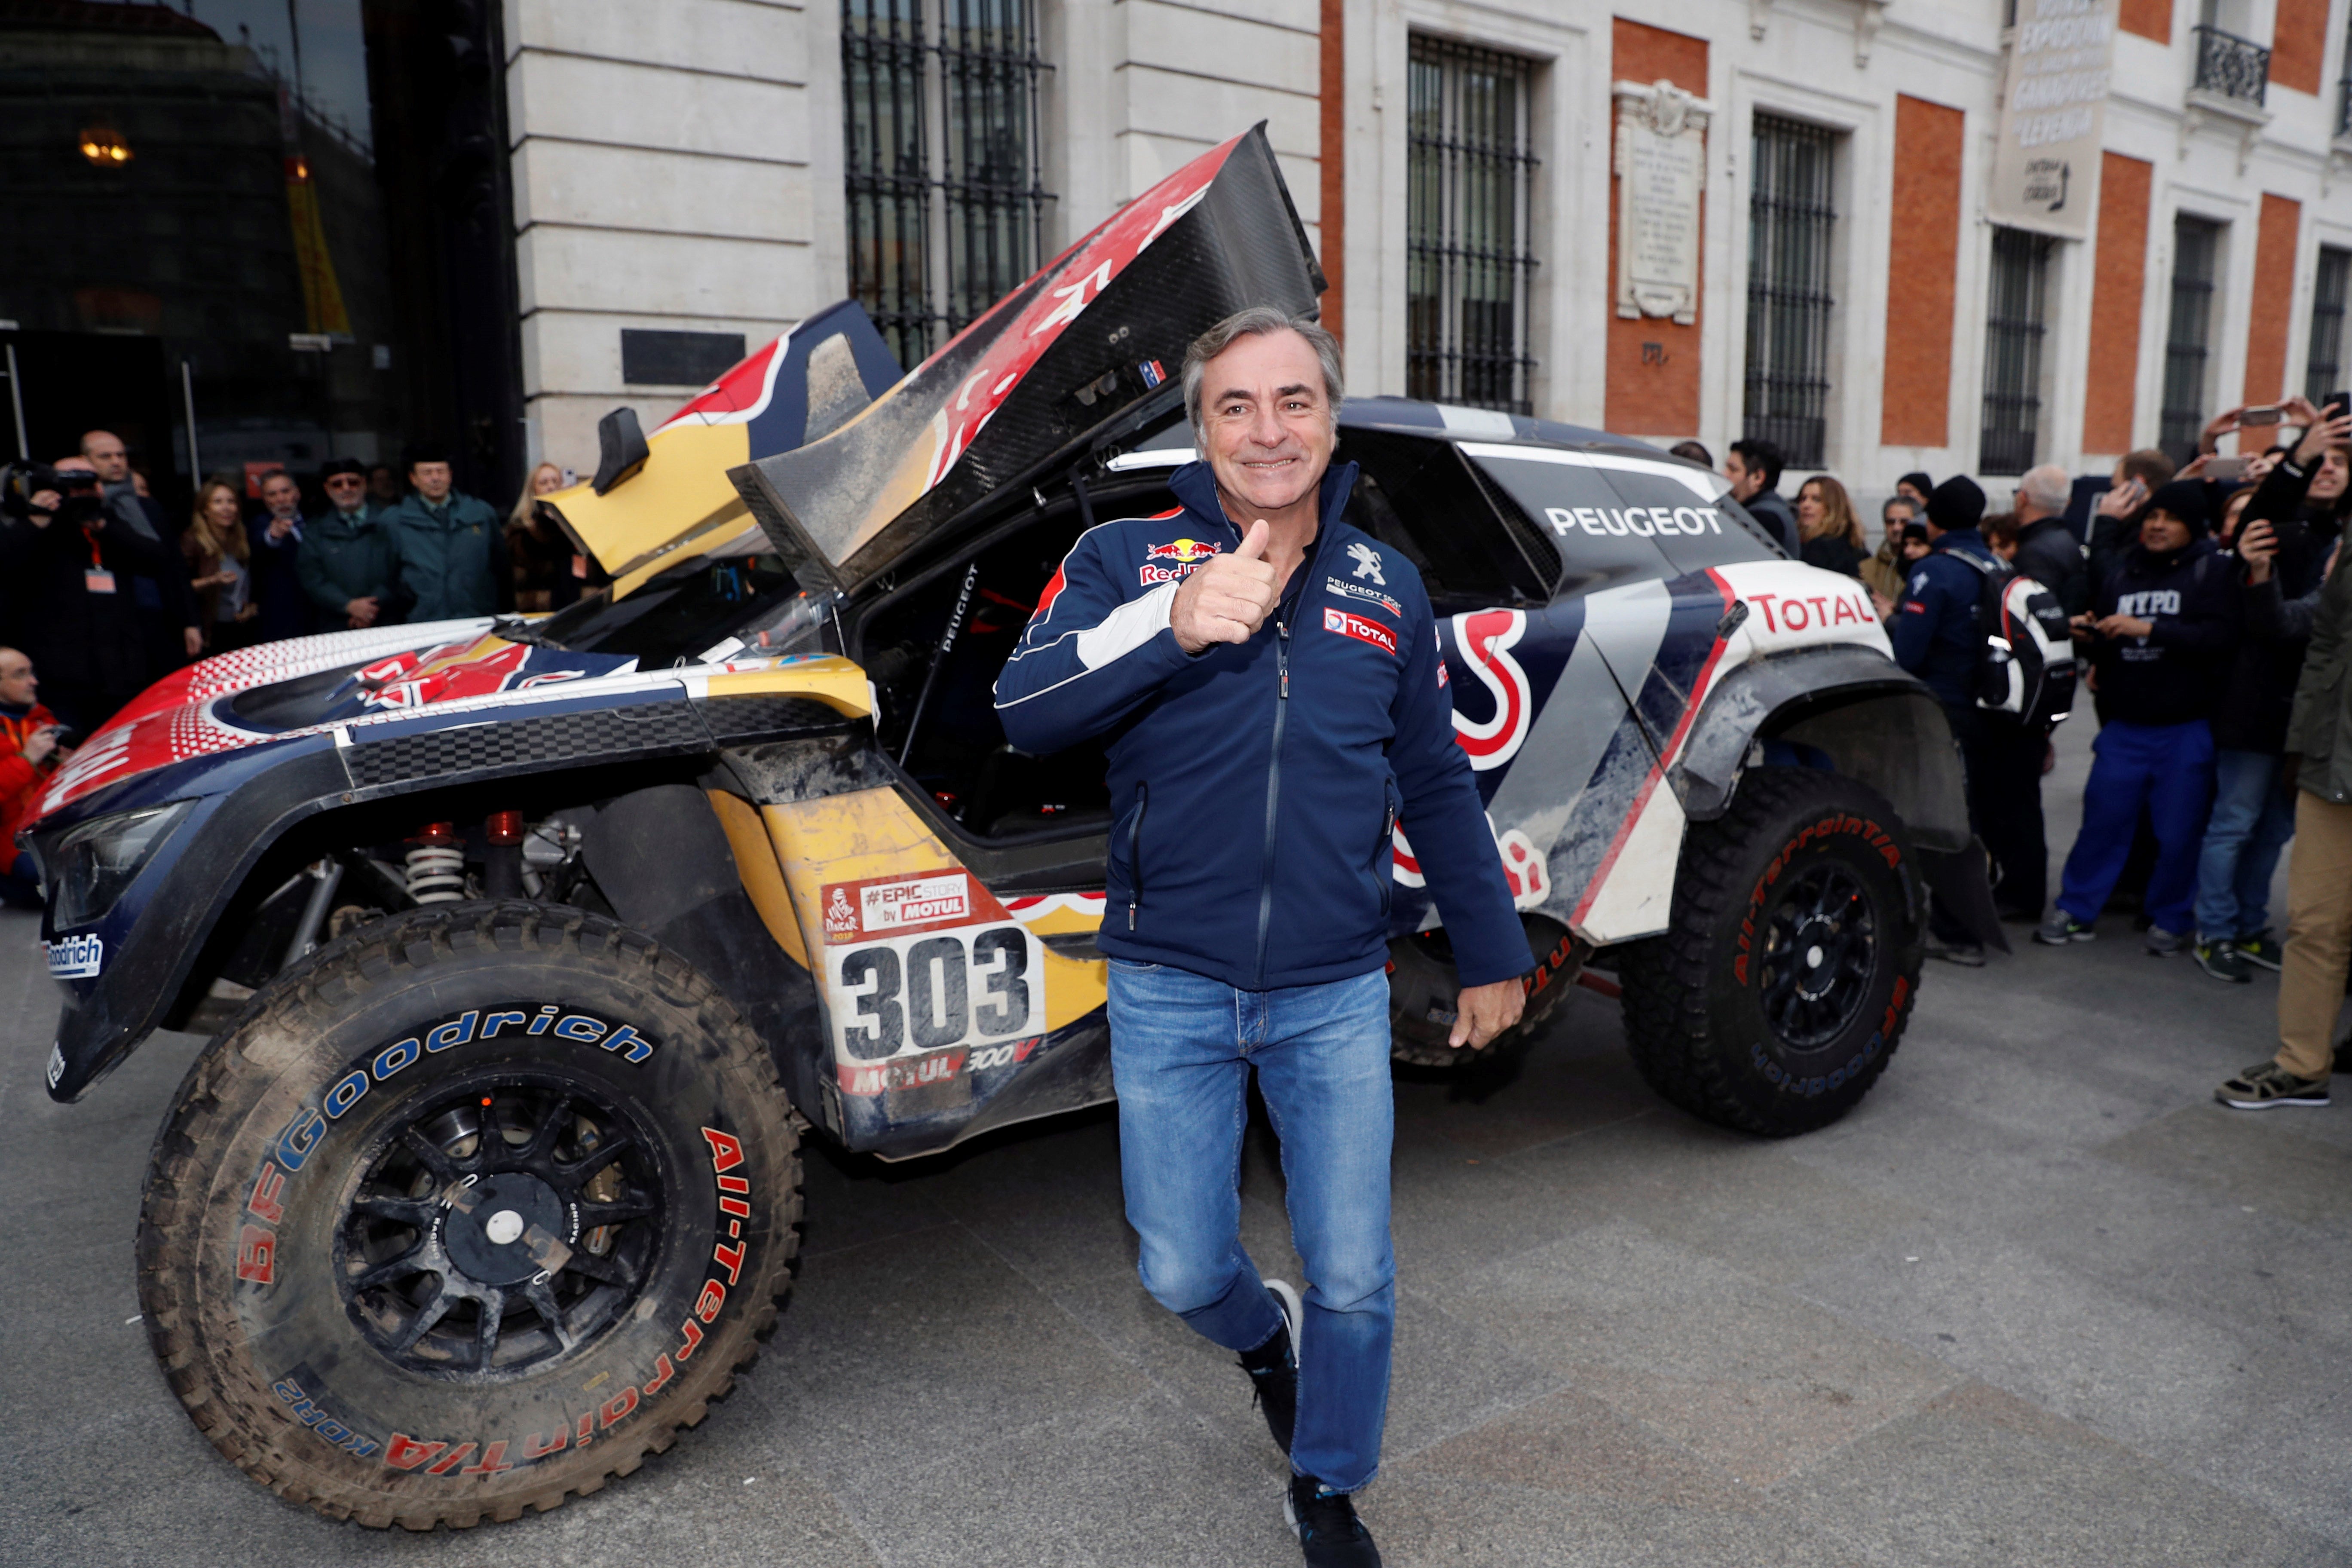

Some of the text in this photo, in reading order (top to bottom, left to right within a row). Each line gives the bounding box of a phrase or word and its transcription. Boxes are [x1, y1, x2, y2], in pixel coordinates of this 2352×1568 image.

[1544, 506, 1723, 538] PEUGEOT
[1140, 563, 1186, 586] Red
[1327, 576, 1382, 598] PEUGEOT
[942, 563, 978, 653] PEUGEOT
[1747, 594, 1874, 634] TOTAL
[1348, 619, 1395, 651] TOTAL
[825, 915, 859, 932] DAKAR
[883, 897, 963, 922] by MOTUL
[840, 927, 1029, 1061] 303
[966, 1037, 1041, 1073] 300V
[236, 1005, 654, 1284] BFGoodrich
[272, 1377, 380, 1458] KDR2
